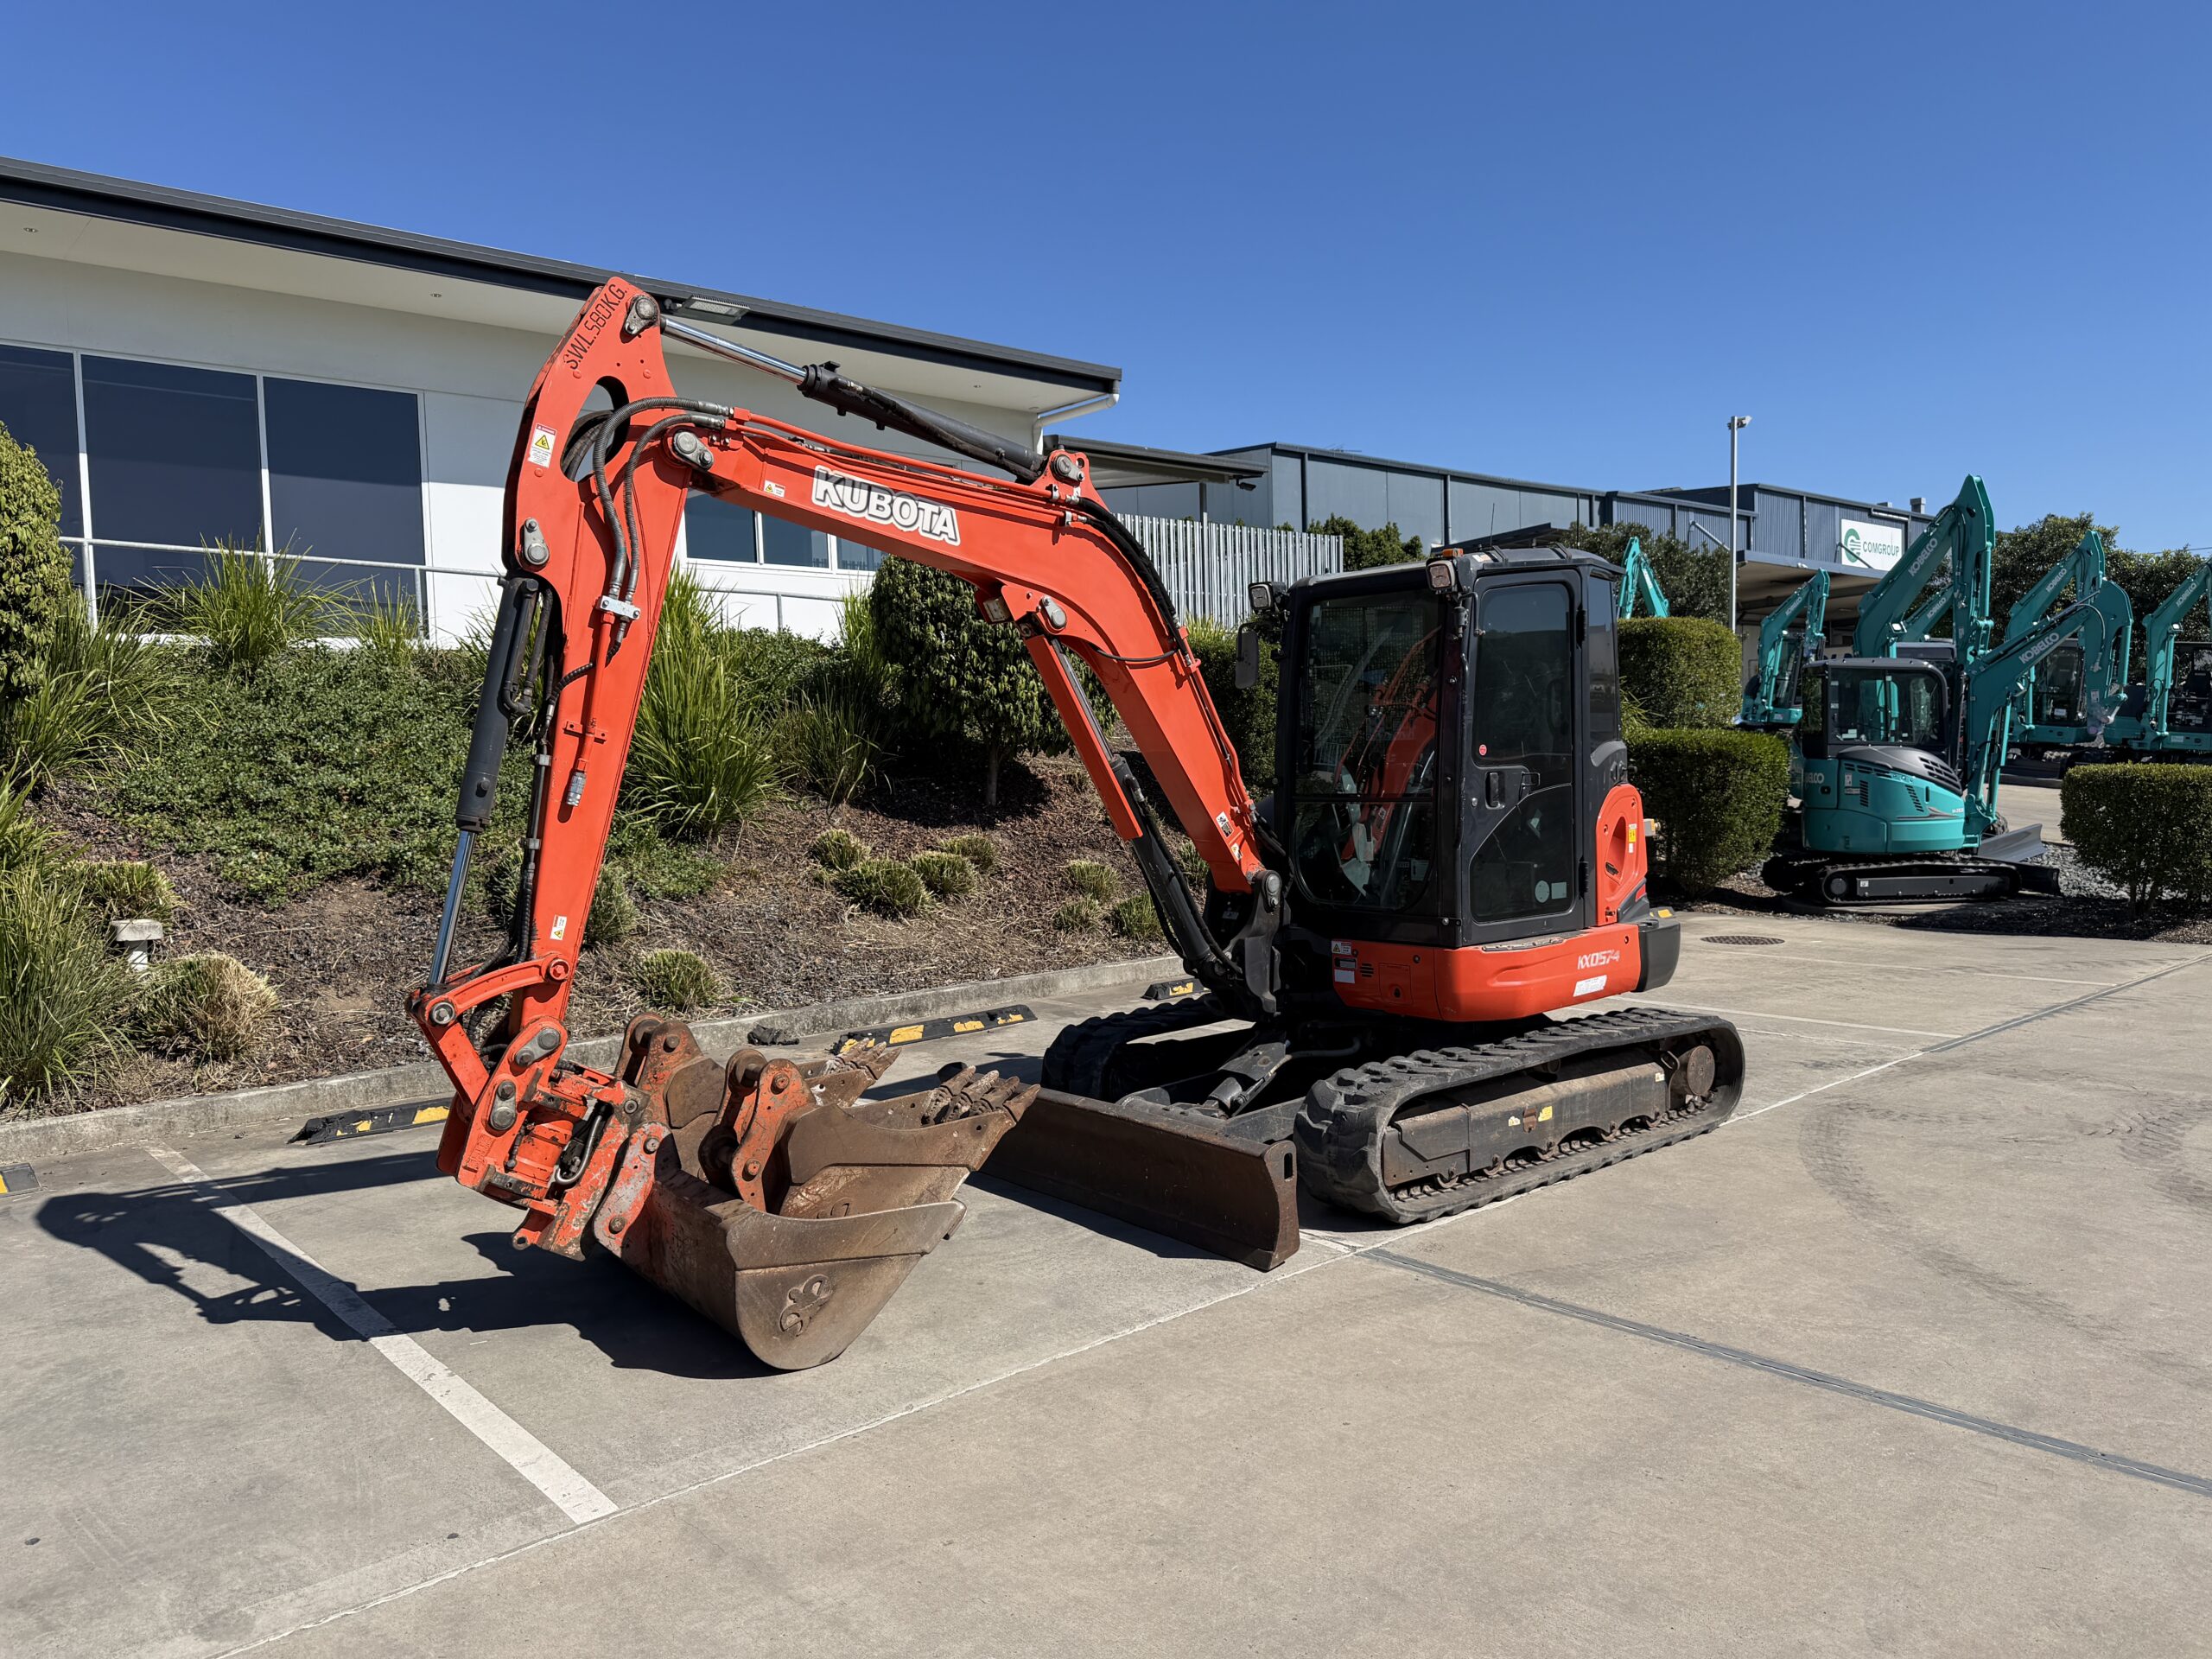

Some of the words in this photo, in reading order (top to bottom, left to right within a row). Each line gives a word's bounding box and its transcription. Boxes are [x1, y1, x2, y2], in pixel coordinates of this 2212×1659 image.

[813, 469, 959, 543] KUBOTA
[1862, 541, 1900, 557] COMGROUP
[1908, 537, 1938, 576] KOBELCO
[2018, 632, 2060, 664] KOBELCO
